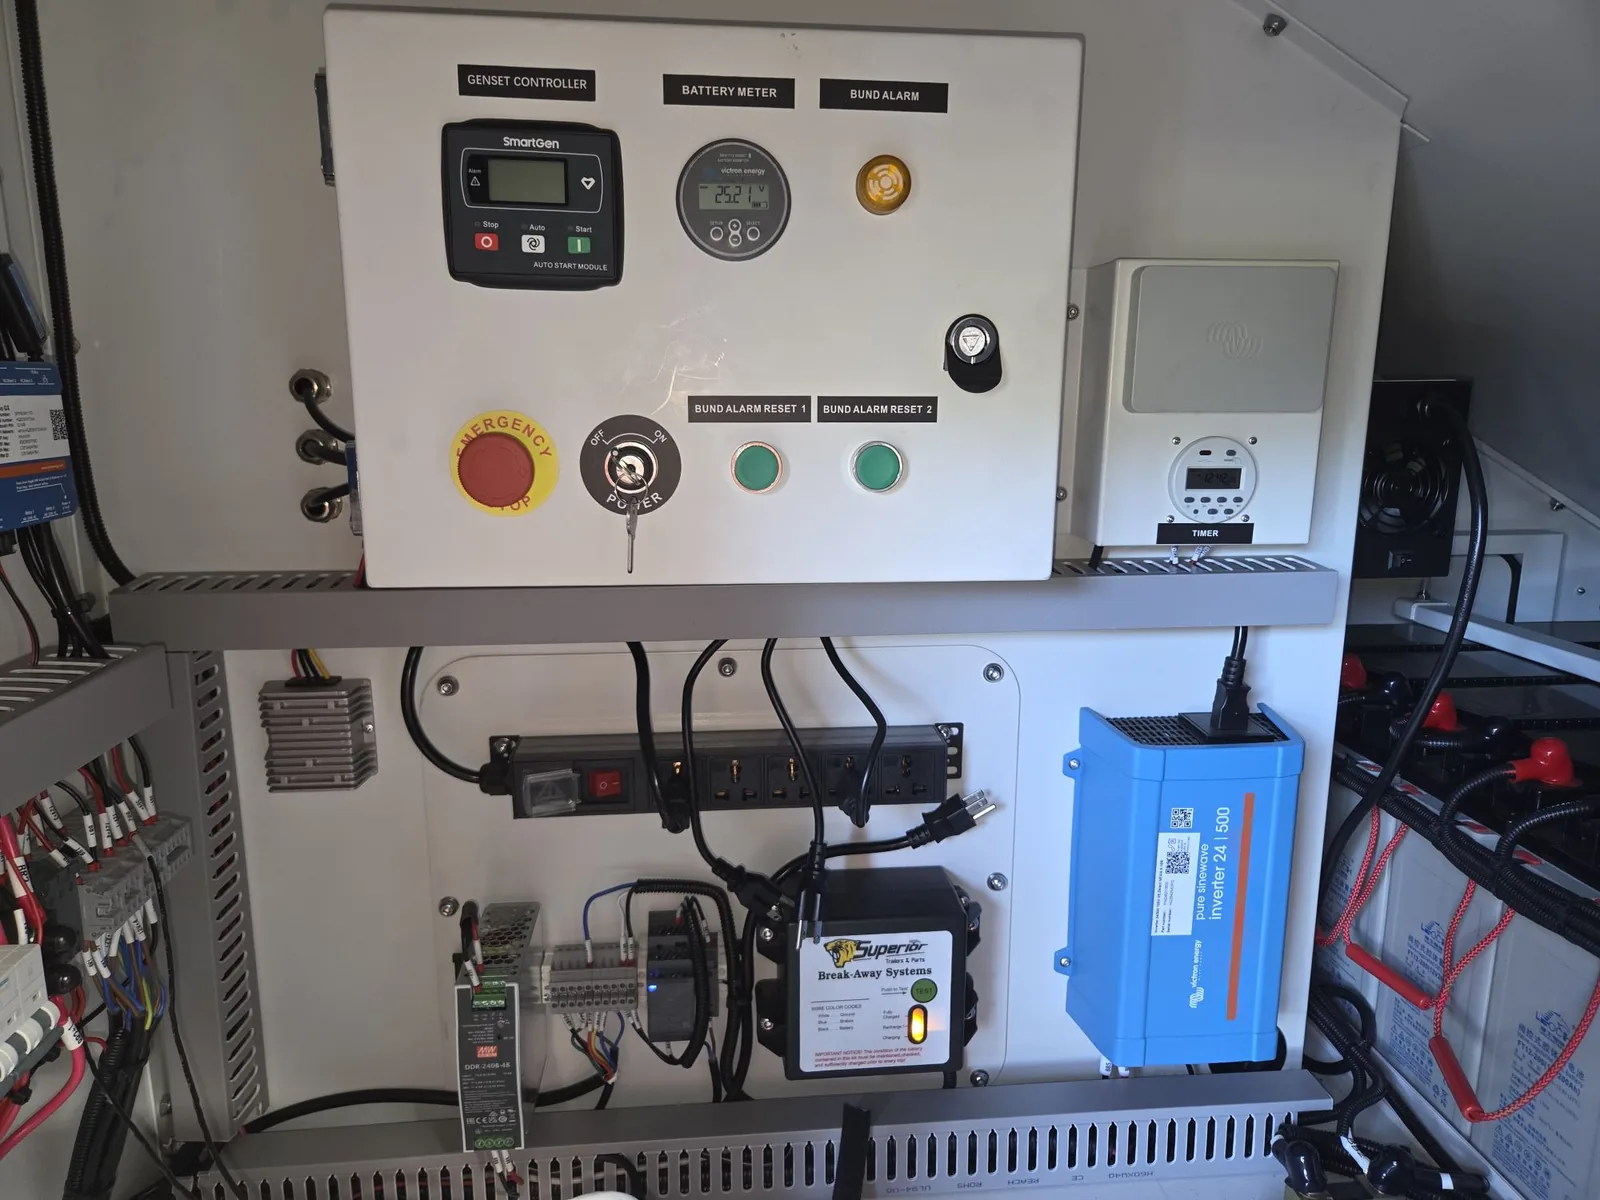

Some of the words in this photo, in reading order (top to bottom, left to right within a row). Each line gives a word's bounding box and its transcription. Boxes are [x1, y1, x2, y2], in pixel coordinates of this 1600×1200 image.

[467, 74, 510, 87] GENSET
[513, 76, 588, 90] CONTROLLER
[682, 85, 734, 97] BATTERY
[737, 87, 777, 98] METER
[850, 89, 880, 100] BUND
[882, 90, 920, 101] ALARM
[503, 136, 560, 149] SmartGen
[482, 220, 499, 229] Stop
[529, 224, 546, 232] Auto
[694, 404, 724, 413] BUND
[726, 404, 762, 413] ALARM
[764, 404, 797, 413] RESET
[801, 404, 806, 413] 1
[823, 405, 852, 414] BUND
[853, 405, 888, 414] ALARM
[890, 405, 923, 414] RESET
[926, 405, 932, 414] 2
[590, 429, 606, 447] OFF
[654, 429, 668, 444] ON
[1216, 807, 1230, 833] 500
[1213, 845, 1227, 863] 24
[1198, 843, 1209, 895] sinewave
[1209, 865, 1226, 920] inverter
[1196, 897, 1206, 920] pure
[856, 940, 928, 960] Superior
[1194, 939, 1202, 963] energy
[818, 969, 882, 980] Break-Away
[886, 967, 932, 977] Systems
